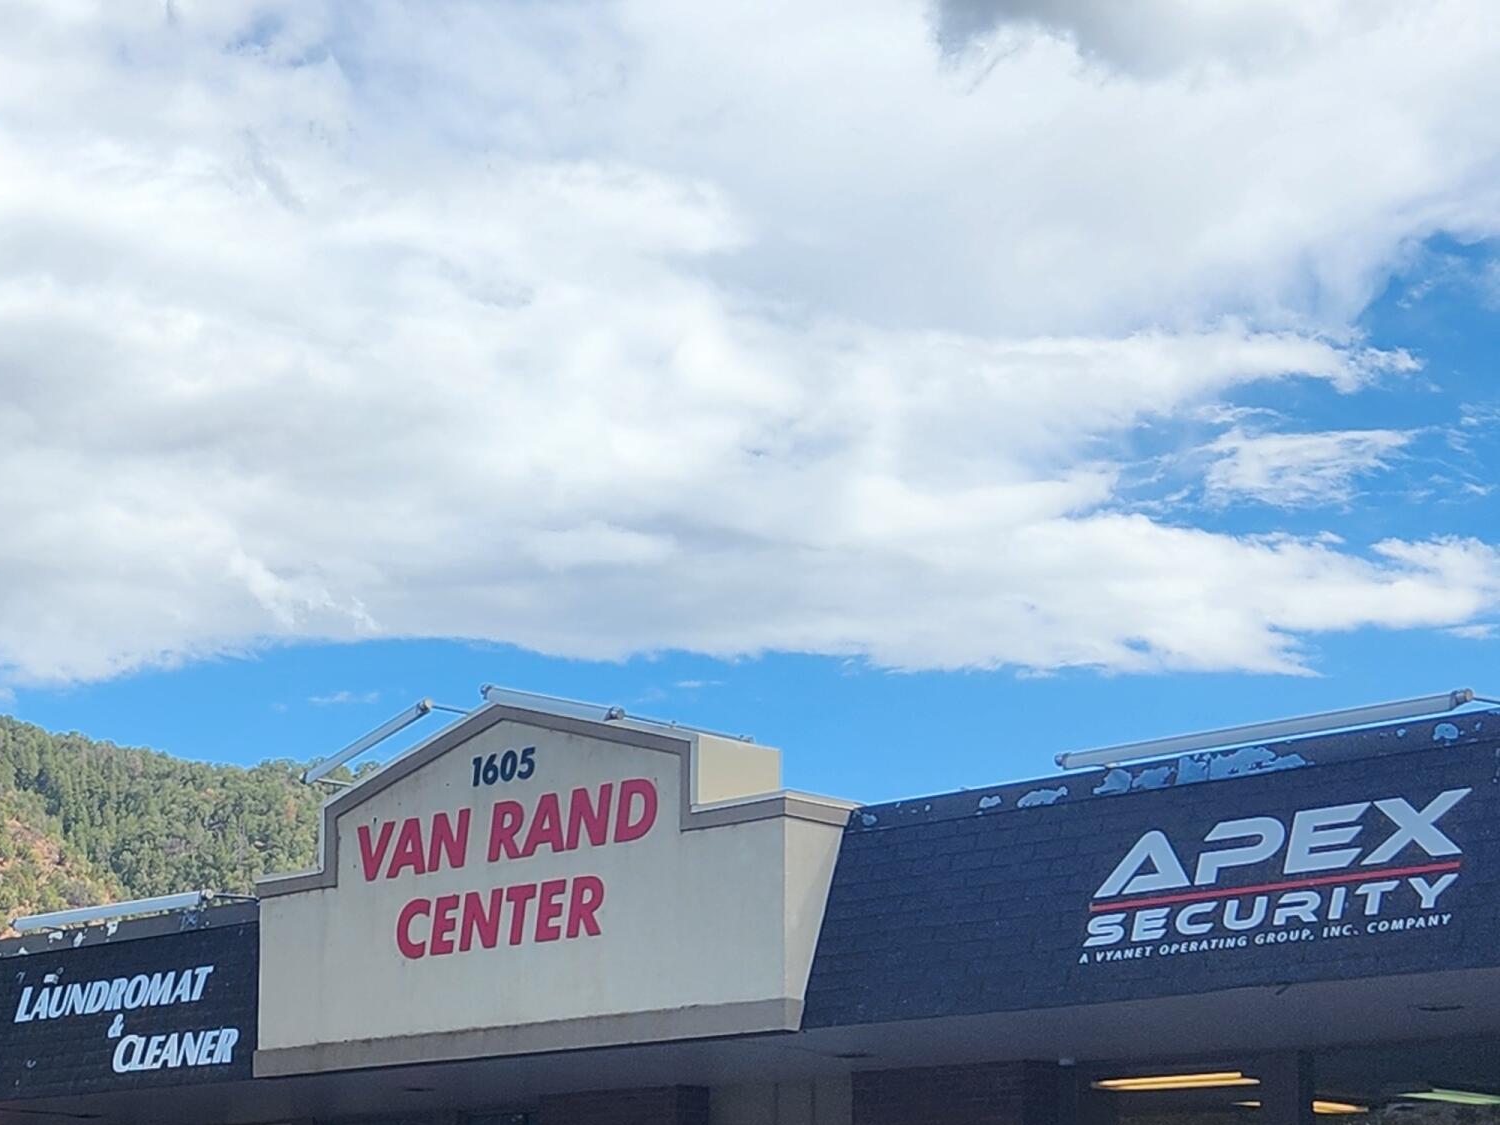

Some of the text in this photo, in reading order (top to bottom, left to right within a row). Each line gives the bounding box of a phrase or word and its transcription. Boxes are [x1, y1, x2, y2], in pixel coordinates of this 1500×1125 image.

[472, 747, 537, 788] 1605
[356, 778, 659, 883] VAN RAND
[1093, 787, 1473, 899] APEX
[396, 875, 605, 960] CENTER
[1078, 952, 1089, 964] A
[1095, 946, 1153, 964] VYANET
[1158, 935, 1248, 956] OPERATING
[1367, 912, 1452, 935] COMPANY
[1082, 872, 1459, 948] SECURITY
[13, 965, 215, 1023] LAUNDROMAT
[107, 1013, 124, 1039] &
[111, 1028, 240, 1074] CLEANER
